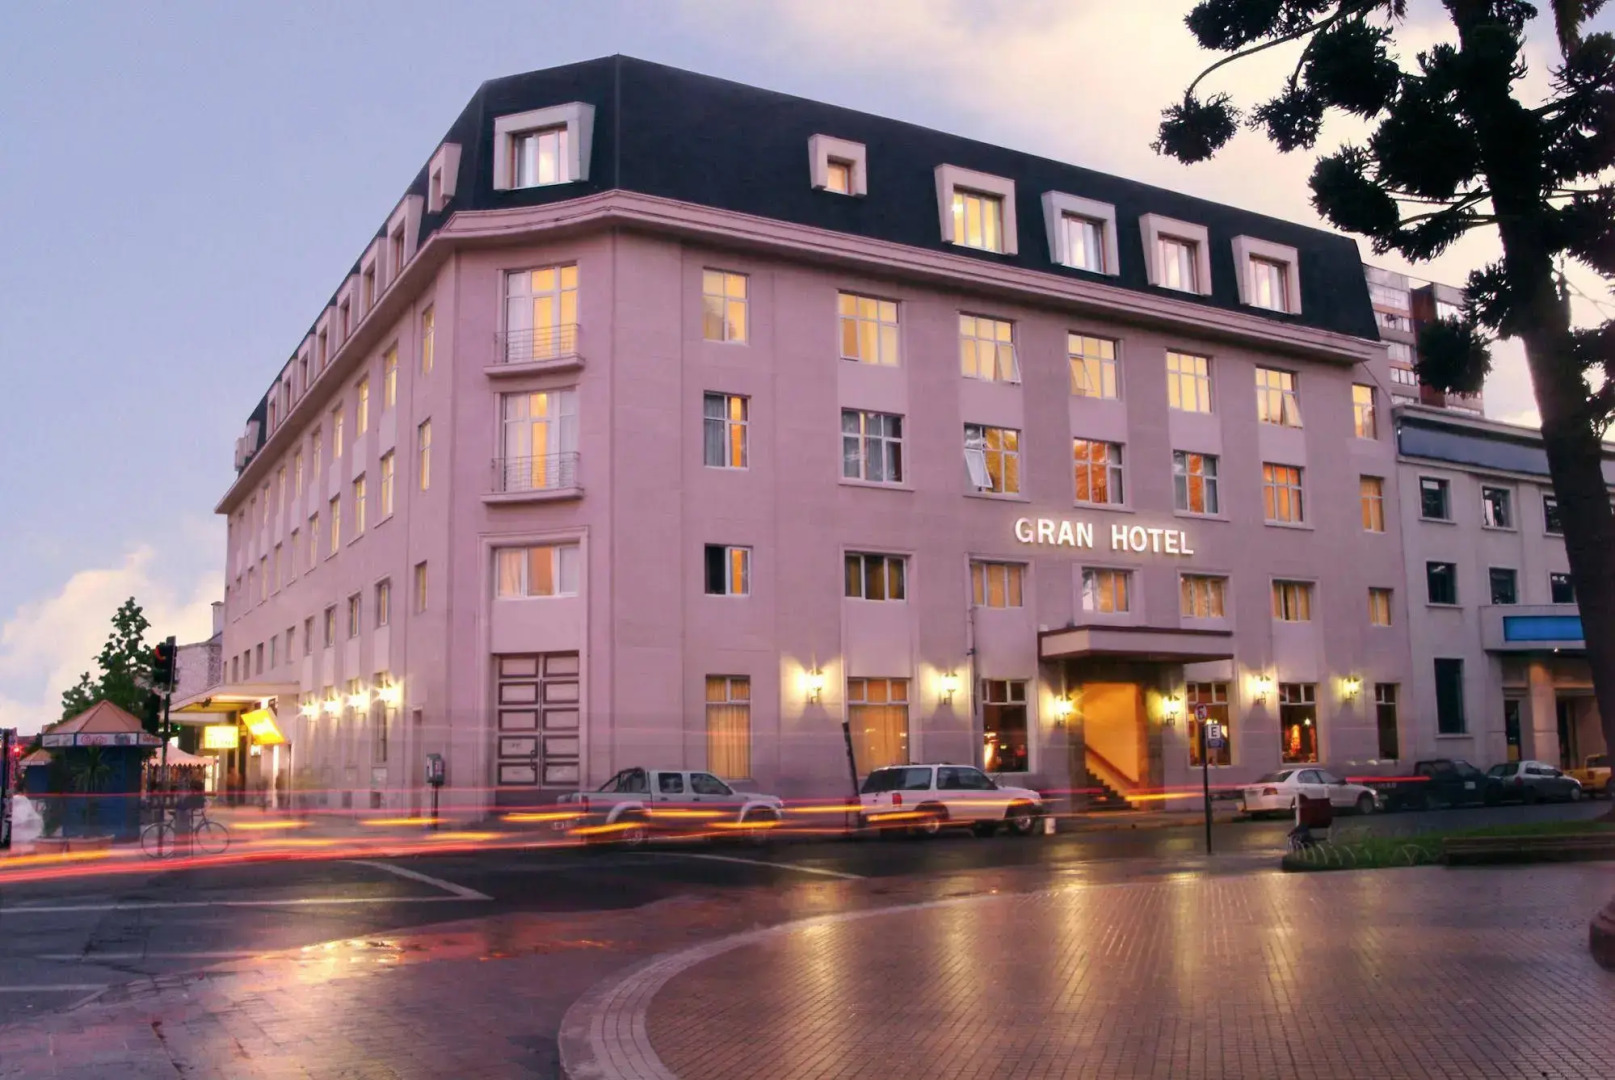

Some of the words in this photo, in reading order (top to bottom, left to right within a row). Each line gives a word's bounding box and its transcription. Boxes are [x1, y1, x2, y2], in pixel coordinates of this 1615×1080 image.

[1015, 517, 1094, 548] GRAN
[1111, 524, 1194, 555] HOTEL
[1211, 726, 1217, 738] E
